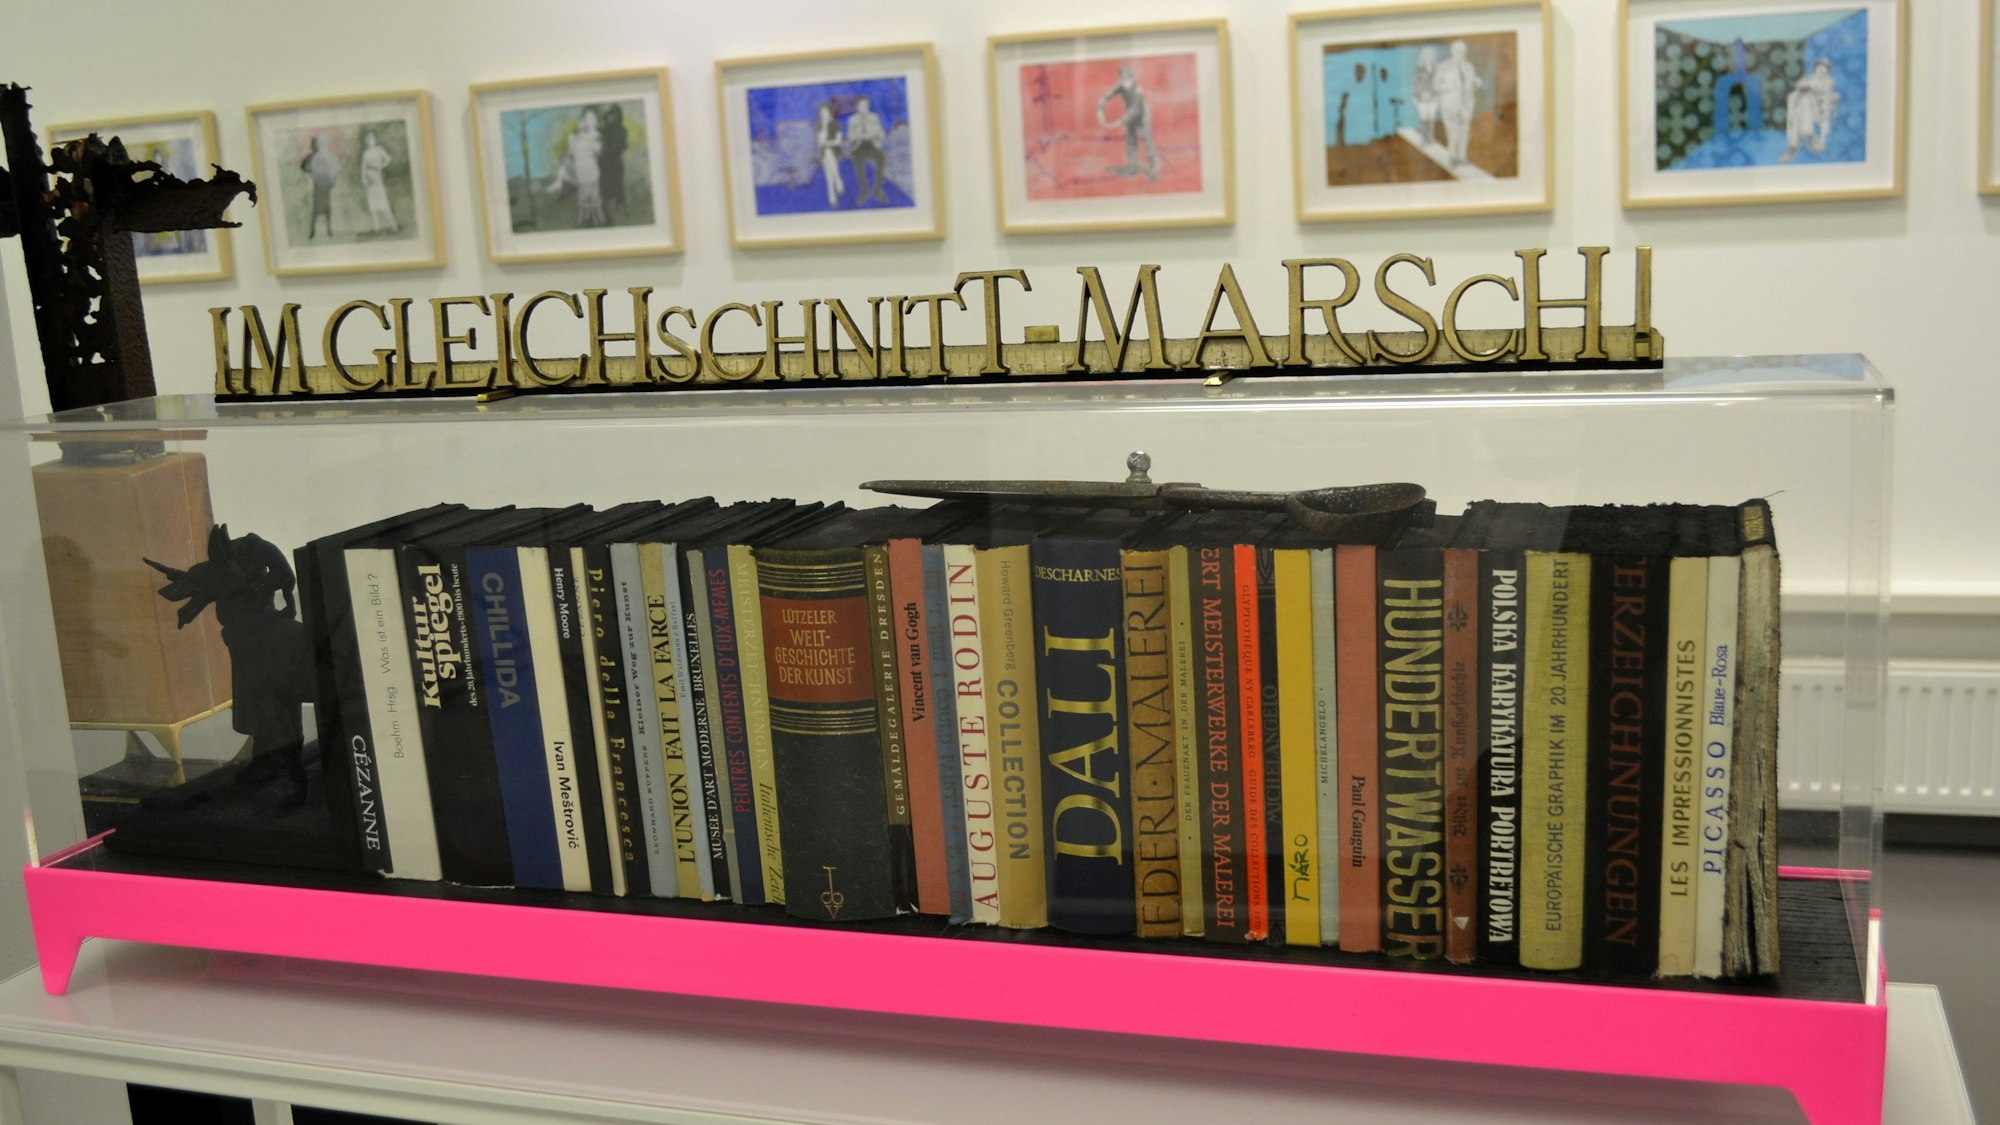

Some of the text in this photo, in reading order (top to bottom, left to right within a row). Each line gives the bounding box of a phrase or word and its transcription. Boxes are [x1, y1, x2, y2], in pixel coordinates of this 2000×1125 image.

[208, 302, 311, 394] IM
[451, 563, 462, 588] heute
[454, 588, 464, 600] bis
[553, 567, 571, 639] Henry Moore
[621, 581, 632, 622] Kunst
[377, 610, 386, 627] ein
[378, 631, 387, 643] ist
[418, 563, 462, 680] spiegel
[482, 572, 521, 709] CHILLIDA
[627, 626, 635, 648] zur
[685, 612, 704, 692] BRUXELLES
[782, 608, 837, 625] LÜTZELER
[790, 629, 831, 647] WELT-
[1551, 559, 1569, 682] JAHRHUNDERT
[378, 647, 391, 674] Was
[411, 596, 442, 710] Kultur
[629, 651, 639, 681] Weg
[775, 647, 856, 665] GESCHICHTE
[779, 666, 854, 686] DER KUNST
[873, 553, 906, 815] GEMÄLDEGALERIE DRESDEN
[904, 601, 925, 723] Vincent van Gogh
[1179, 640, 1187, 687] MALEREI
[1203, 598, 1229, 772] MEISTERWERKE
[1247, 677, 1254, 693] NY
[468, 694, 478, 707] des
[588, 568, 635, 861] Piero della Francesca
[632, 684, 646, 735] Kleiner
[647, 594, 696, 865] L'UNION FAIT LA FARCE
[694, 698, 713, 769] MODERNE
[720, 673, 745, 743] CONTENTS
[736, 562, 769, 769] MEISTERZEICHNUNGEN
[759, 782, 778, 859] Italienische
[997, 560, 1030, 860] Howard Greenberg COLLECTION
[1180, 690, 1188, 713] DER
[1247, 695, 1256, 759] CARLSBERG
[1549, 716, 1565, 733] IM
[392, 720, 404, 759] Boehm
[948, 562, 1000, 912] AUGUSTE RODIN
[1044, 625, 1122, 866] DALI
[1183, 735, 1191, 796] FRAUENAKT
[1262, 685, 1282, 824] MICHELANGELO
[1318, 700, 1329, 784] MICHELANGELO
[1384, 579, 1445, 961] HUNDERTWASSER
[1488, 569, 1518, 943] POLSKA KARYKATURA PORTRETOWA
[1670, 639, 1695, 897] LES IMPRESSIONNISTES
[1703, 644, 1729, 875] PICASSO Blaue-Rosa
[352, 734, 380, 850] CÉZANNE
[553, 741, 580, 849] Ivan Meštrović
[703, 773, 718, 811] D'ART
[729, 748, 751, 813] PEINTRES
[1210, 781, 1230, 828] DER
[1249, 769, 1257, 800] GUIDE
[1548, 734, 1565, 818] GRAPHIK
[649, 797, 660, 855] LEONHARD
[1250, 803, 1258, 829] DES
[1350, 775, 1366, 868] Paul Gauguin
[1213, 833, 1235, 928] MALEREI
[1251, 832, 1261, 907] COLLECTIONS
[1546, 821, 1564, 932] EUROPÄISCHE
